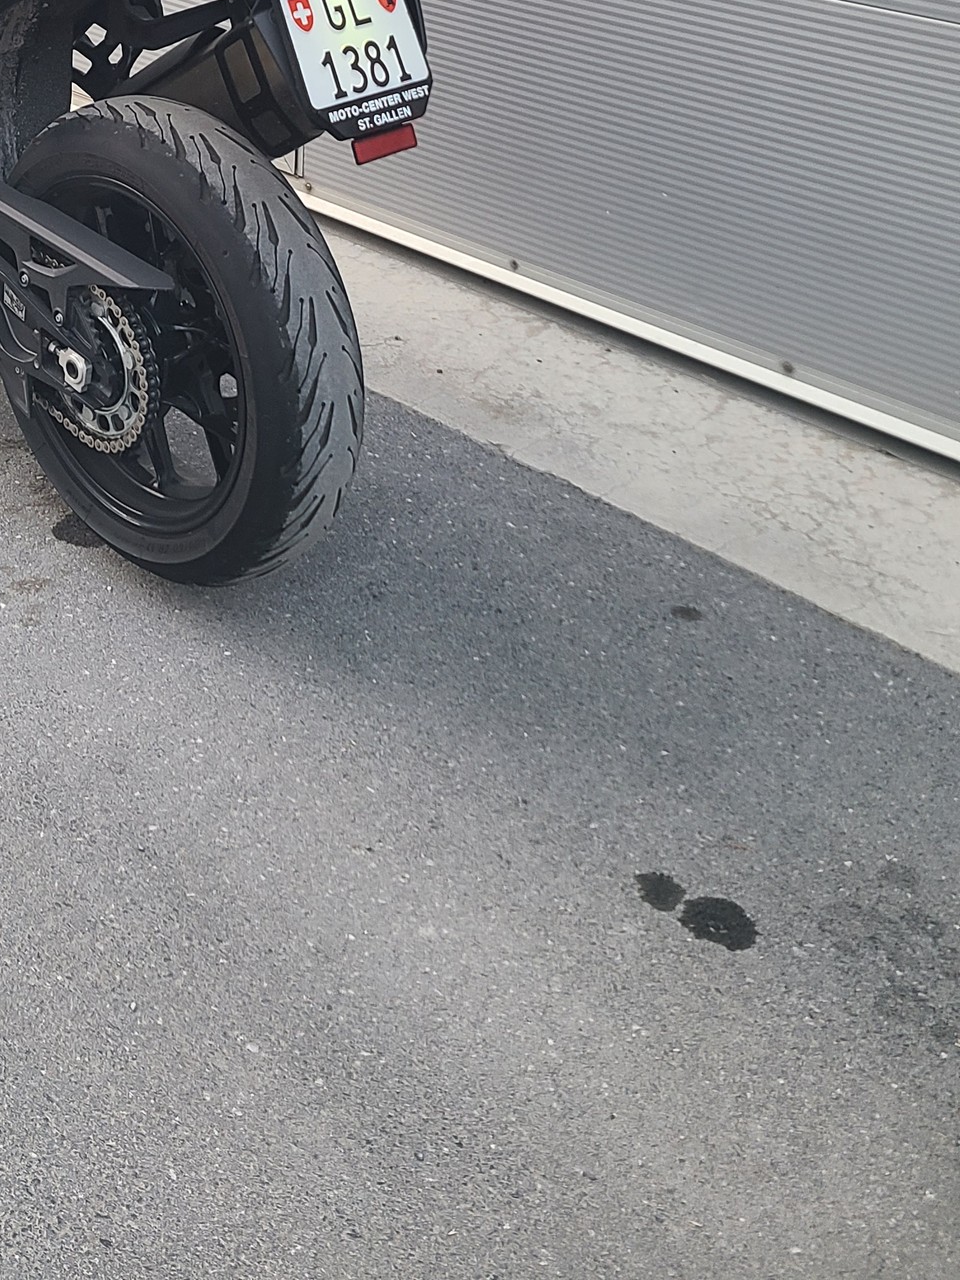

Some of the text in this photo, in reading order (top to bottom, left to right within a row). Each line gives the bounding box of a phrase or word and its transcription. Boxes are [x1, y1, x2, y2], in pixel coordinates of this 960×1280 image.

[321, 35, 412, 99] 1381
[328, 85, 429, 123] MOTO-CENTER WEST
[357, 105, 412, 131] ST. GALLEN
